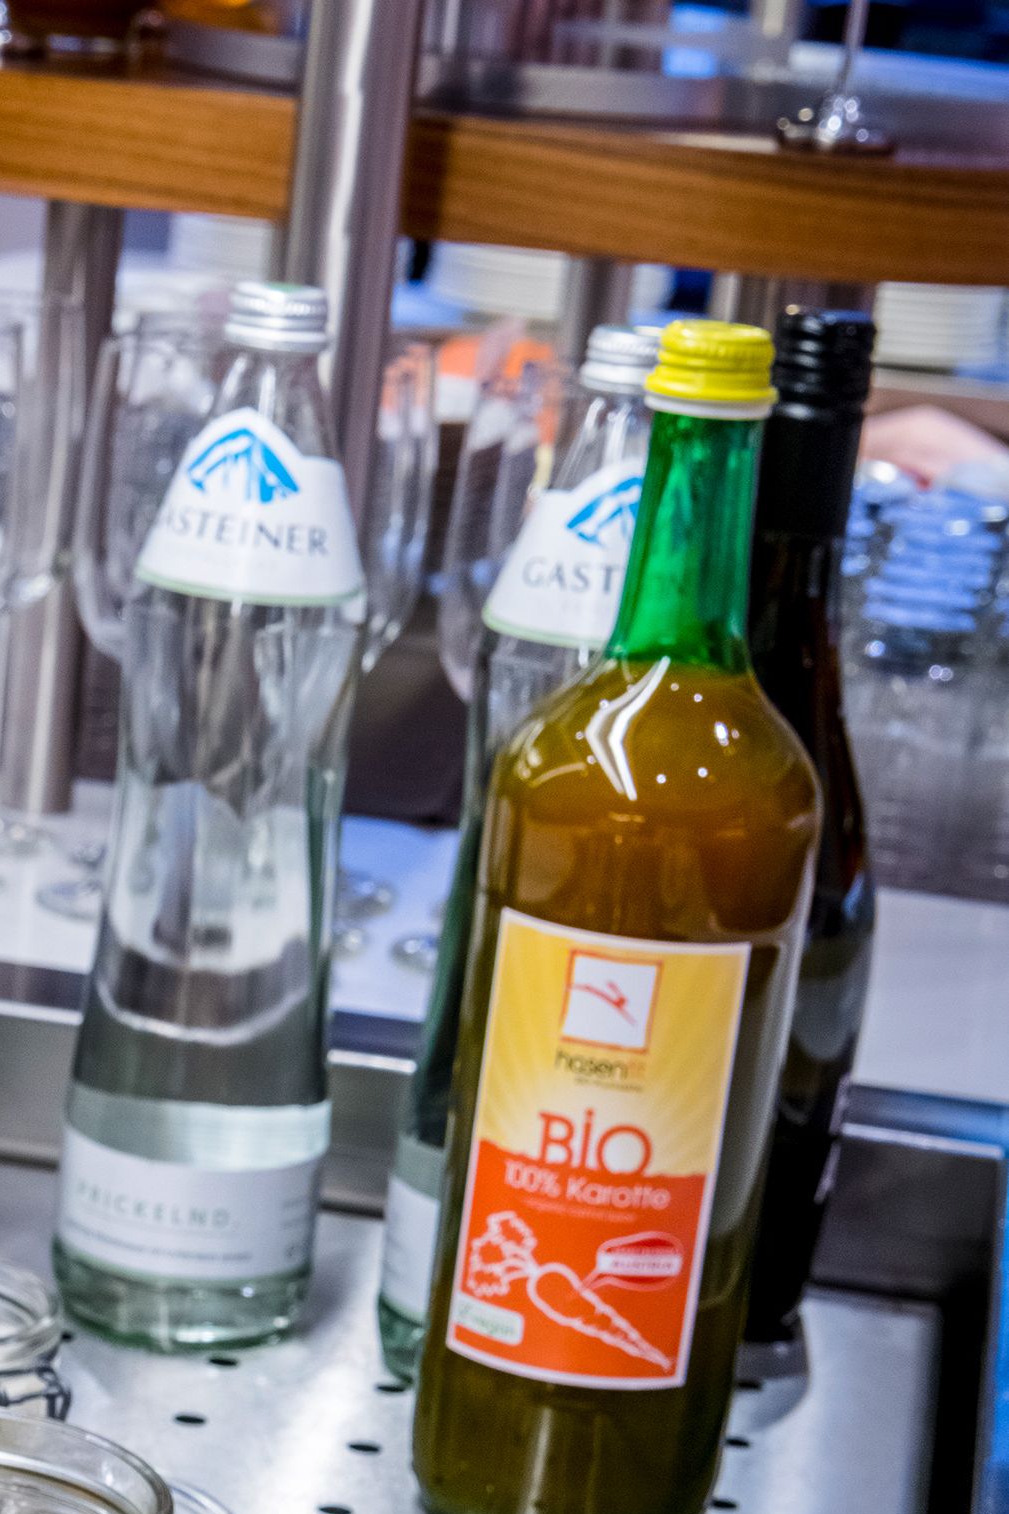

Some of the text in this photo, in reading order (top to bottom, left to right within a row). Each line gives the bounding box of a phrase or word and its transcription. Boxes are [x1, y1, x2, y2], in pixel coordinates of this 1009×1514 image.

[522, 557, 621, 595] GAST
[504, 1159, 561, 1198] 100%
[566, 1176, 671, 1211] Karotte
